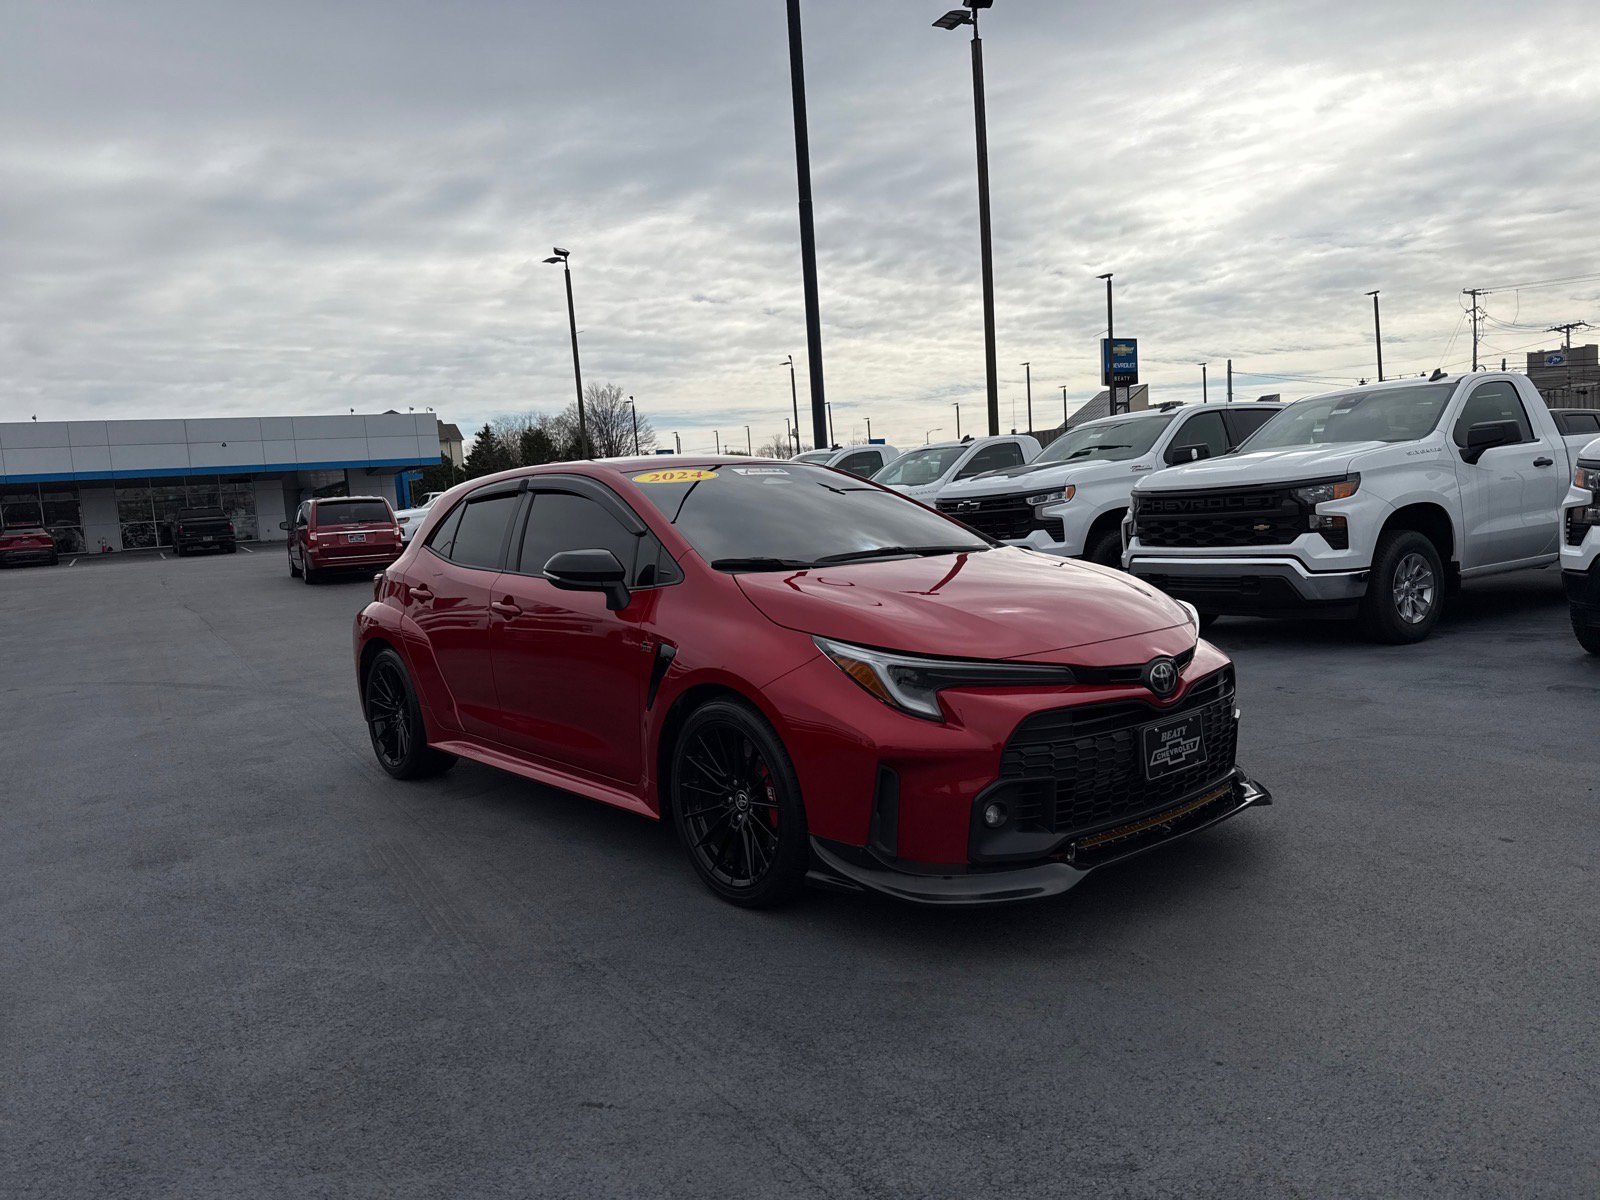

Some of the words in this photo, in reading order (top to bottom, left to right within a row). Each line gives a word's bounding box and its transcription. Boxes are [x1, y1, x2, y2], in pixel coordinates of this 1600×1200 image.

[650, 471, 703, 482] 2024
[1141, 494, 1280, 512] CHEVROLET
[1161, 725, 1188, 742] BEATY
[1156, 742, 1194, 760] CHEVROLET
